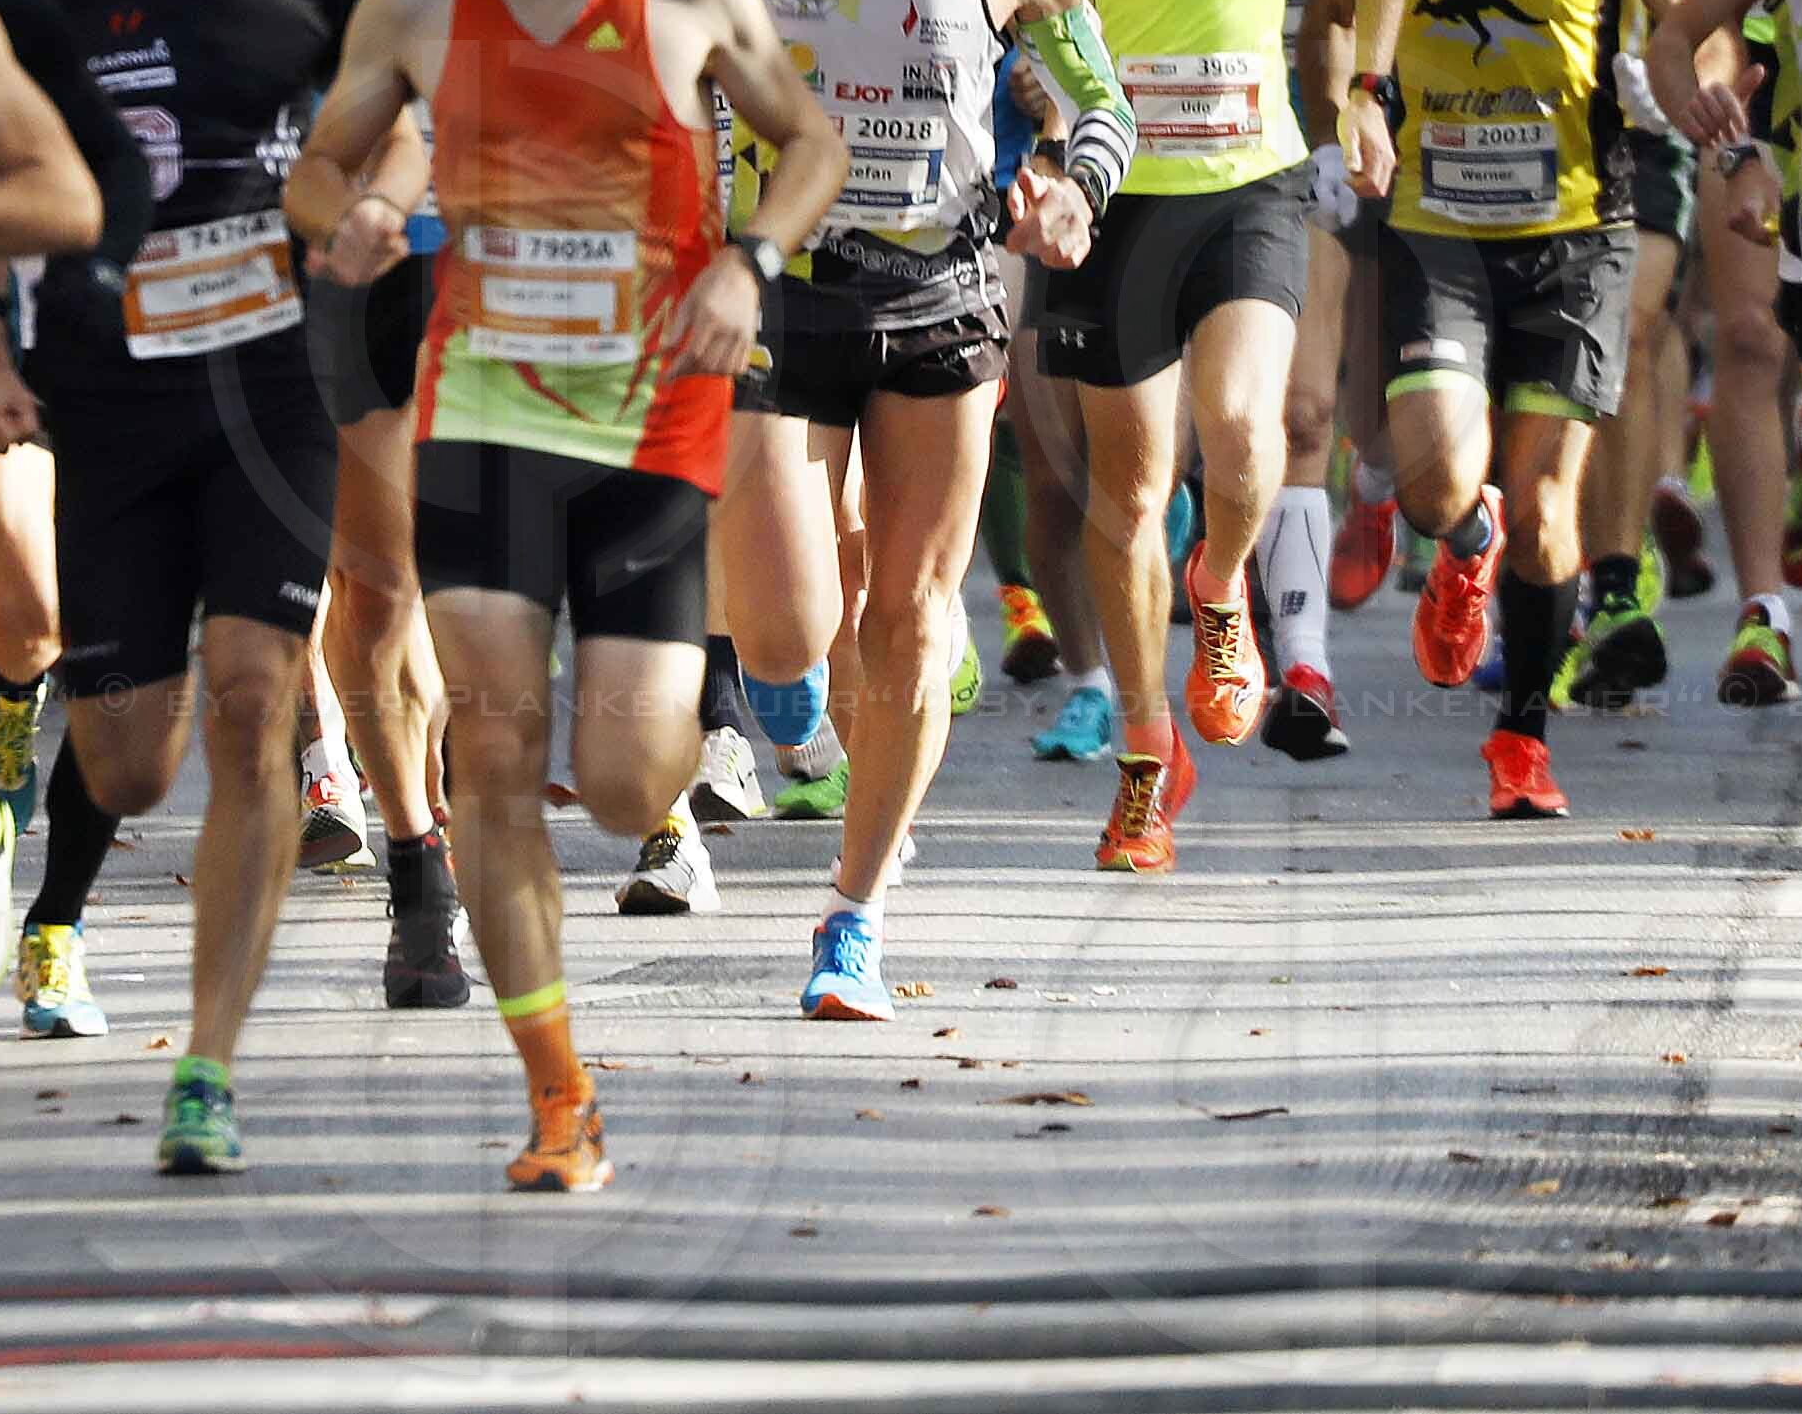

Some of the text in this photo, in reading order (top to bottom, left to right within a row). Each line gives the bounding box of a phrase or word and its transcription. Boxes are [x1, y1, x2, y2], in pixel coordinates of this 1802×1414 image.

[1195, 57, 1248, 77] 3965
[834, 81, 895, 104] EJOT
[1180, 99, 1212, 116] Udo
[857, 116, 932, 141] 20018
[1476, 125, 1542, 146] 20013
